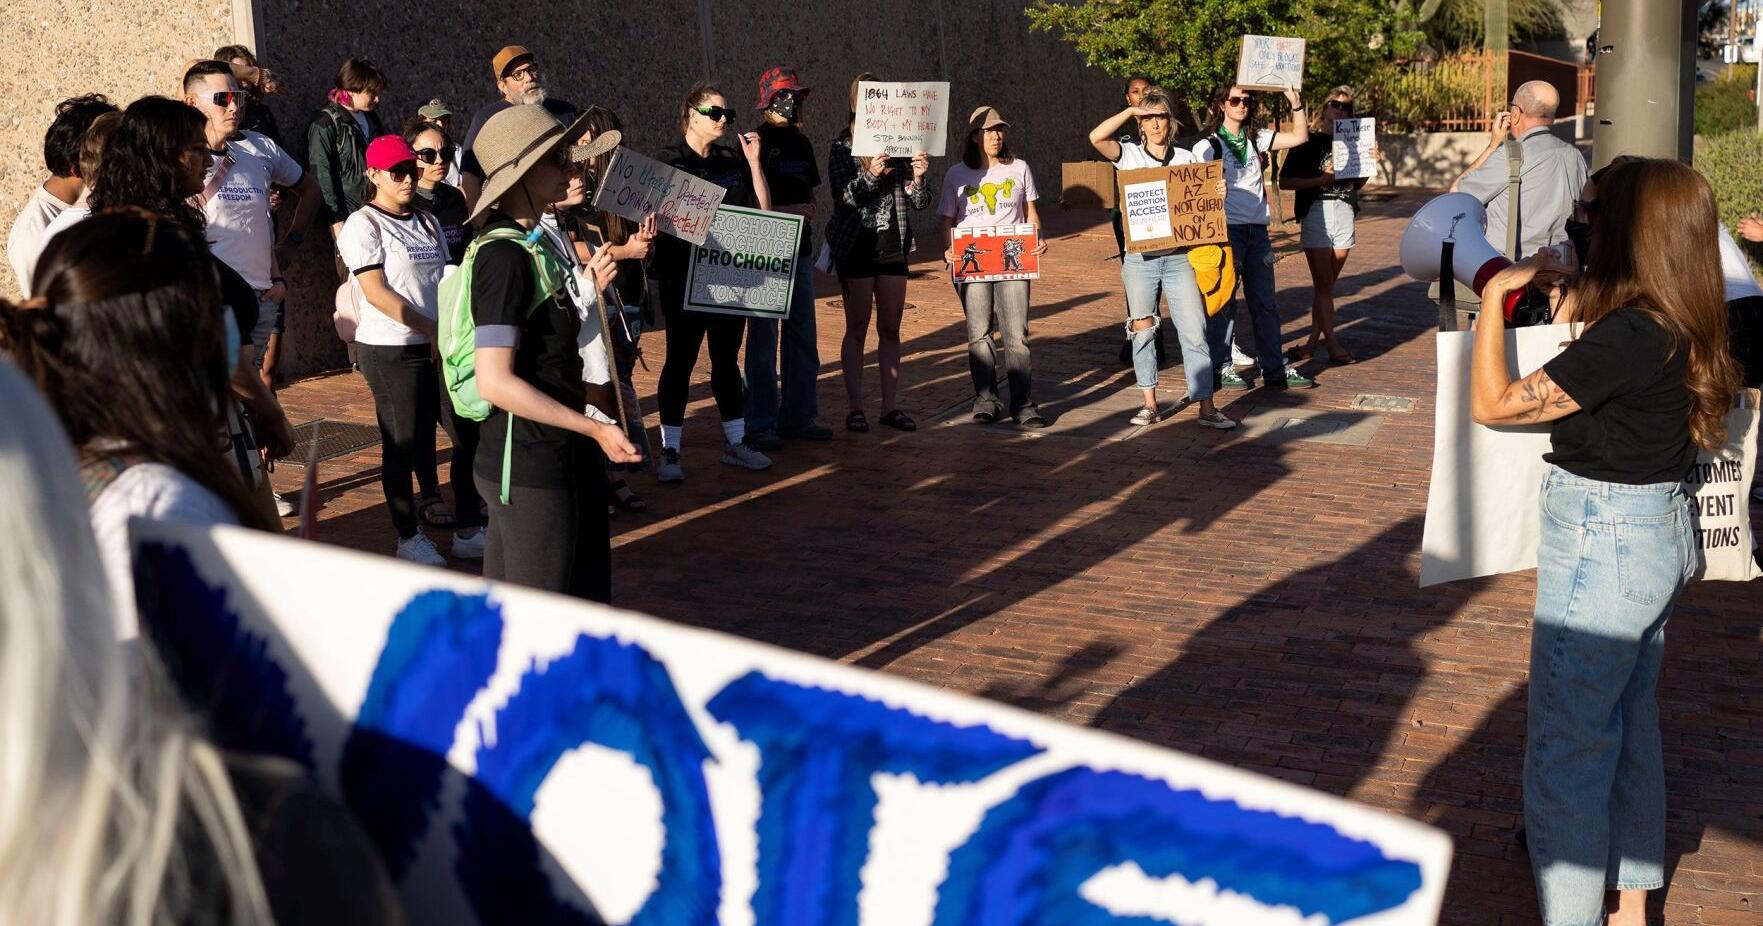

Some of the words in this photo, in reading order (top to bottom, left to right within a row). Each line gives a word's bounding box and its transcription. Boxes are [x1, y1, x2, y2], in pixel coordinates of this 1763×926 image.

[865, 88, 889, 101] 1864
[895, 88, 917, 99] LAWS
[881, 104, 903, 116] RIGHT
[921, 104, 932, 116] MY
[866, 118, 889, 131] BODY
[873, 134, 894, 143] STOP
[613, 152, 634, 180] No
[1169, 164, 1217, 184] MAKE
[1127, 188, 1165, 200] PROTECT
[1184, 183, 1209, 199] AZ
[999, 201, 1018, 209] TOUCH
[1128, 197, 1166, 208] ABORTION
[1174, 199, 1196, 215] NOT
[1129, 205, 1167, 218] ACCESS
[1192, 213, 1207, 224] ON
[713, 213, 797, 241] ROCHOICE
[953, 224, 1034, 240] FREE
[713, 231, 794, 257] ROCHOICE
[408, 252, 440, 260] FREEDOM
[955, 271, 1039, 282] PALESTINE
[1693, 526, 1740, 550] TIONS
